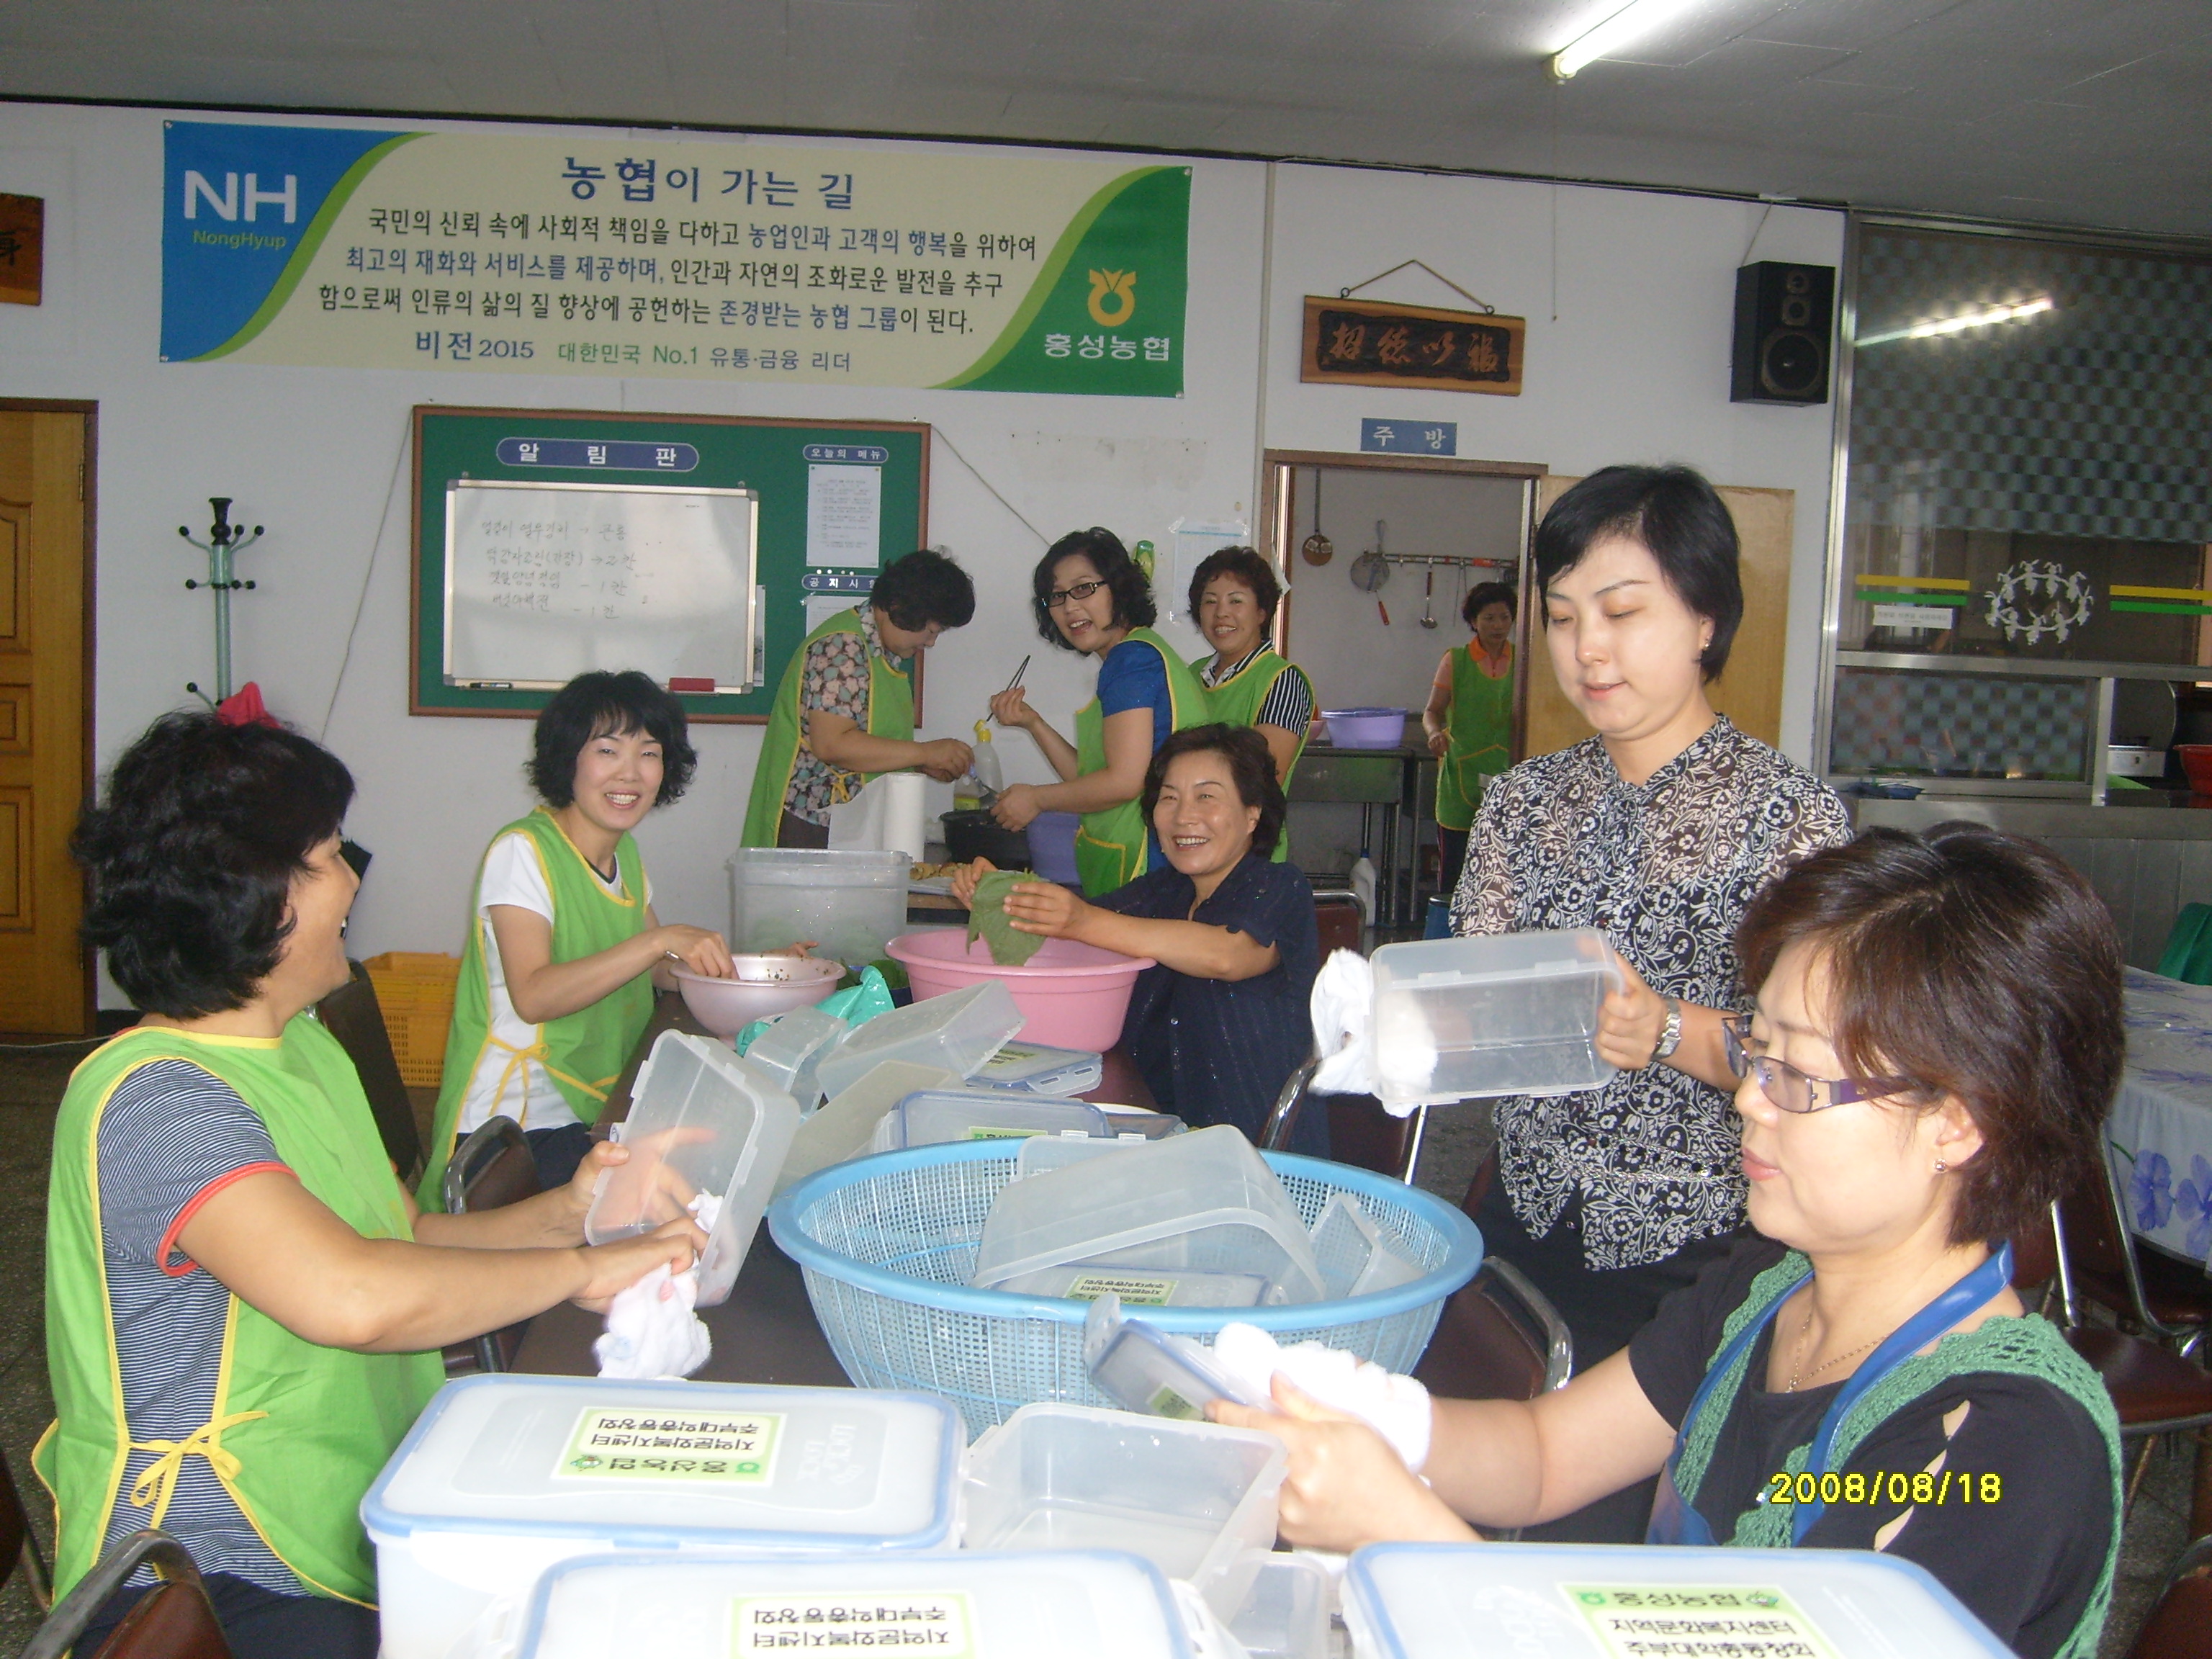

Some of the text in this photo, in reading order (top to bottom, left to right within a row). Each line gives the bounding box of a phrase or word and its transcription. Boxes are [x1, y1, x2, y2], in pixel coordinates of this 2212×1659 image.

[562, 157, 852, 210] 농협이 가는 길
[184, 171, 296, 223] NH
[194, 230, 287, 251] NongHyup
[369, 209, 1035, 261] 국민의 신뢰 속에 사회적 책임을 다하고 농업인과 고객의 행복을 위하여
[346, 247, 1002, 297] 최고의 재화와 서비스를 제공하며, 인간과 자연의 조화로운 발전을 추구
[319, 284, 973, 334] 함으로써 인류의 삶의 질 향상에 공헌하는 존경받는 농협 그룹이 된다.
[1045, 333, 1169, 361] 홍성농협
[558, 343, 640, 364] 대한민국
[654, 345, 696, 364] No.1
[812, 352, 849, 372] 리더
[811, 448, 880, 460] 오늘의 메뉴
[598, 1418, 758, 1434] 주부대학총동창회
[591, 1433, 755, 1452] 지역문화복지센터
[609, 1457, 727, 1473] 홍성농협
[1613, 1591, 1742, 1608] 홍성농협
[755, 1606, 947, 1624] 주부대학총동창회
[1609, 1618, 1797, 1635] 지역문화복지센터
[754, 1629, 950, 1647] 지역문화복지센터
